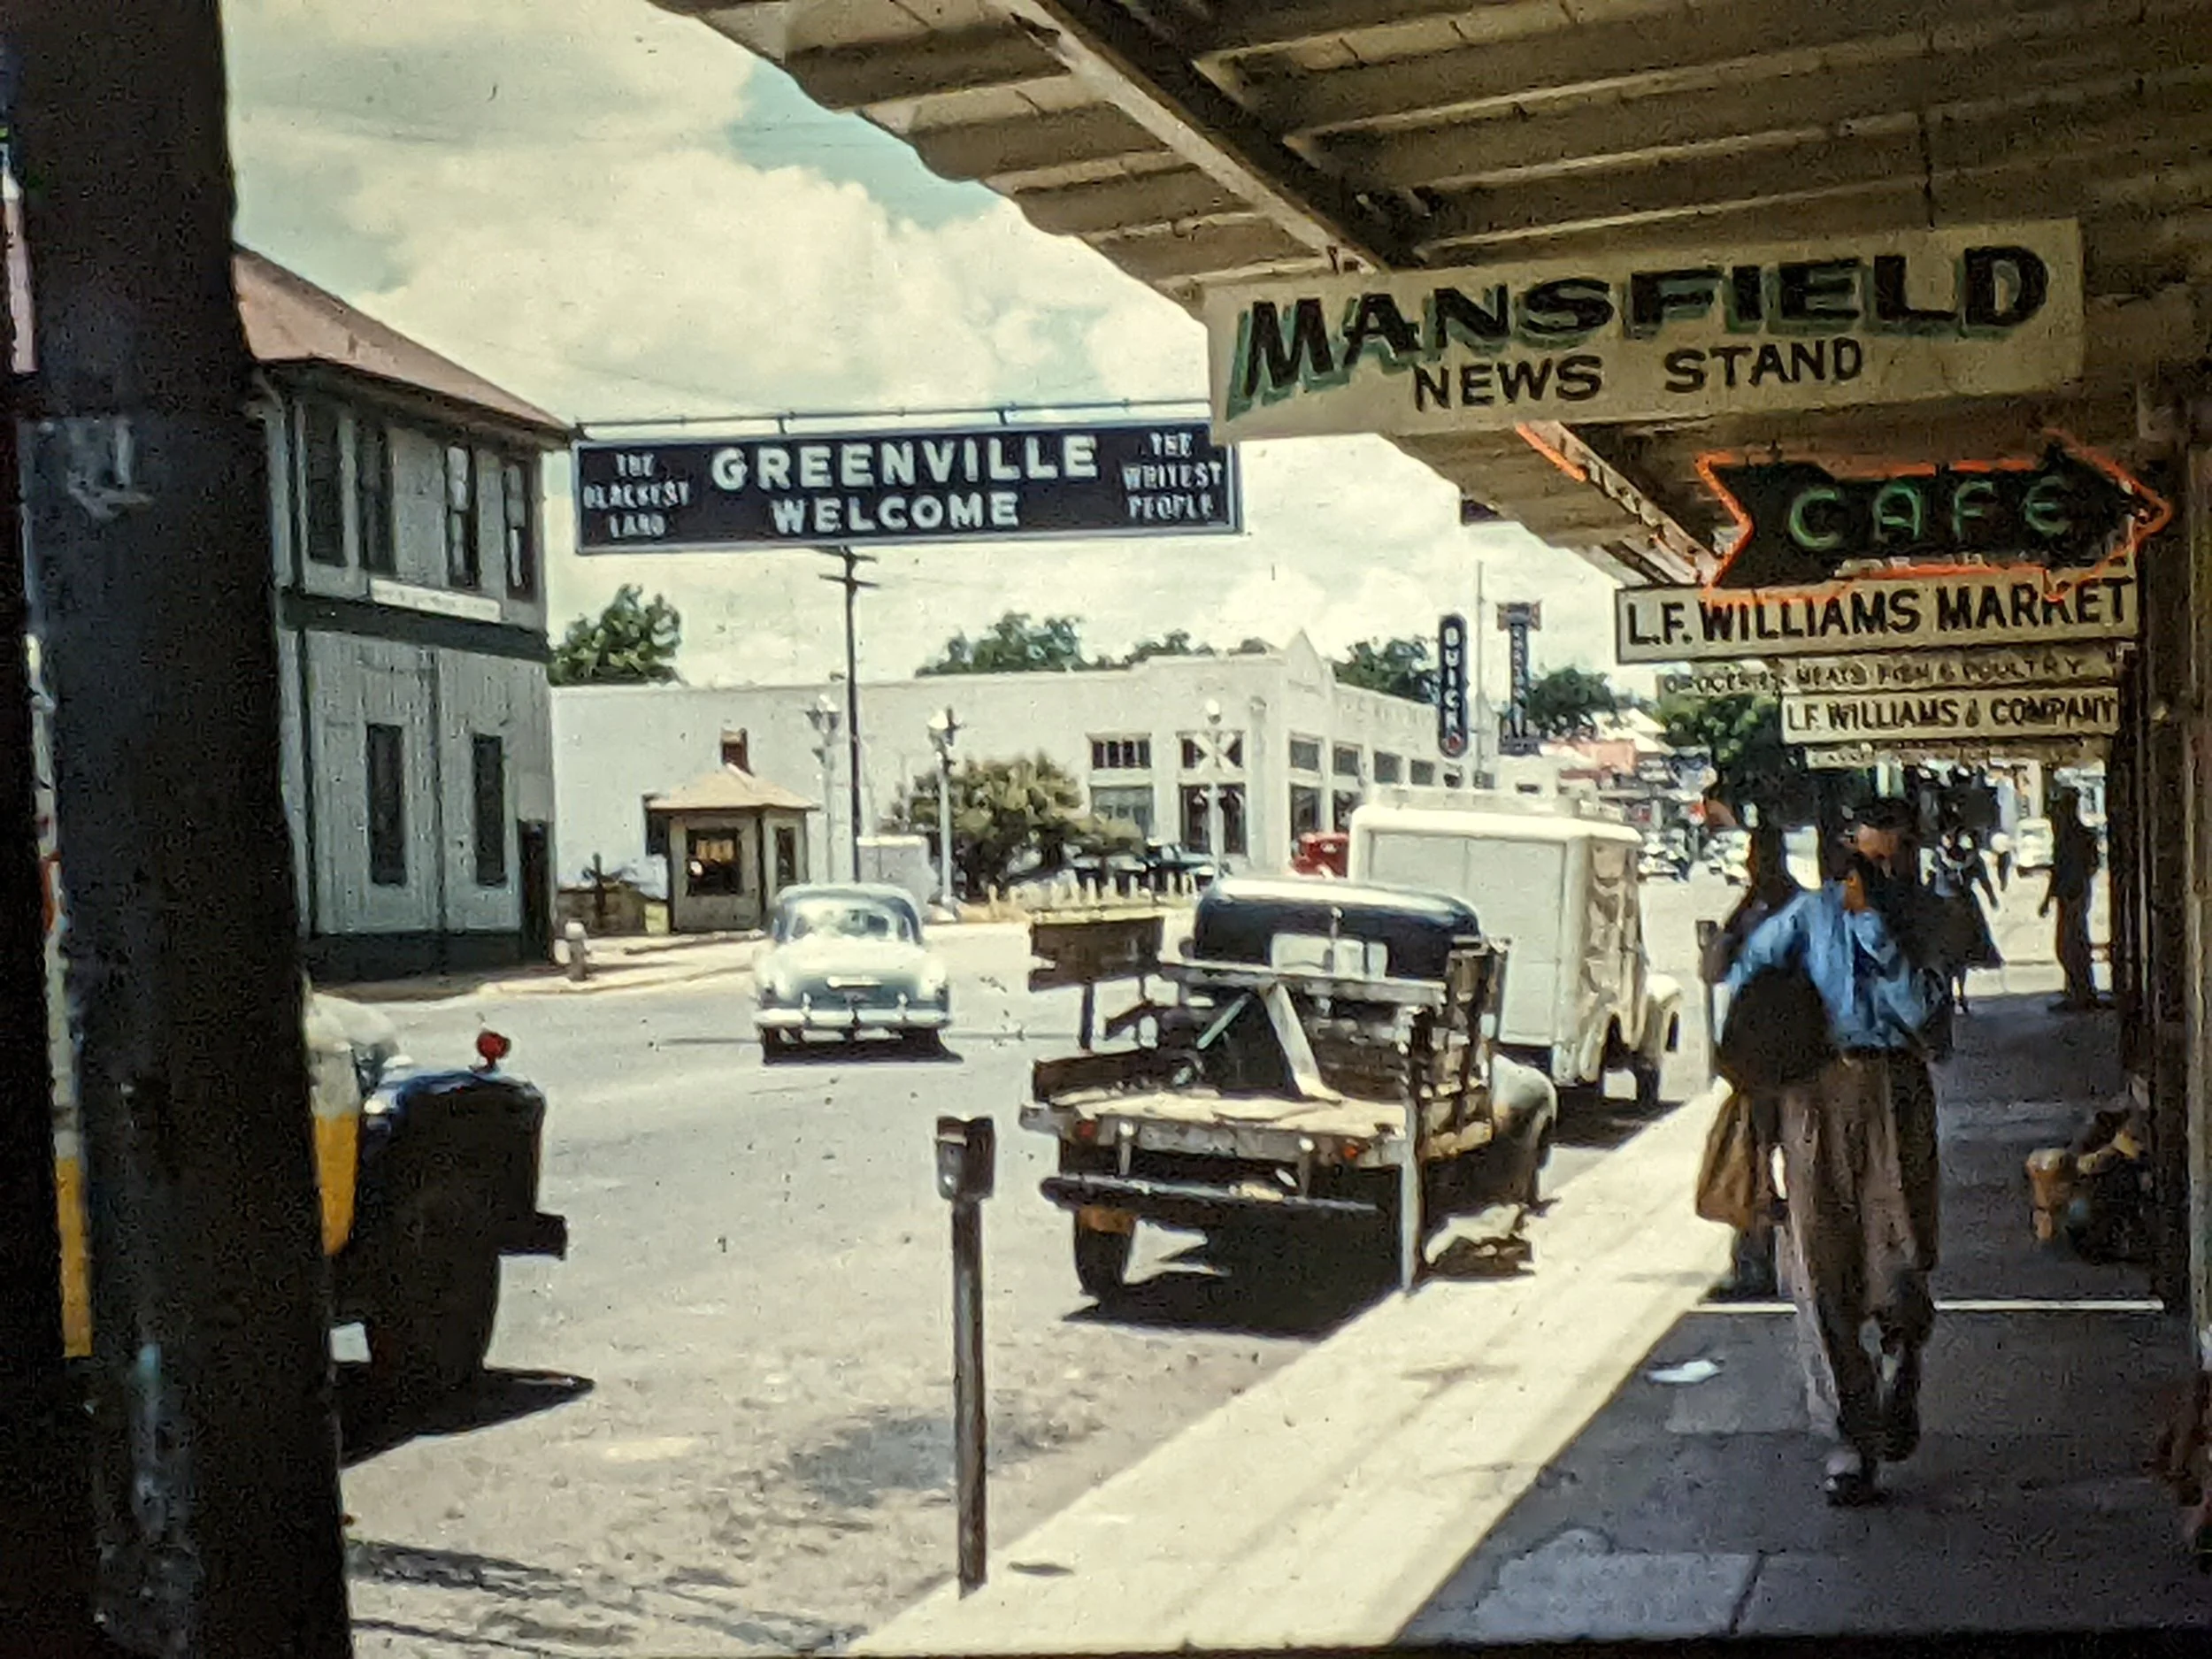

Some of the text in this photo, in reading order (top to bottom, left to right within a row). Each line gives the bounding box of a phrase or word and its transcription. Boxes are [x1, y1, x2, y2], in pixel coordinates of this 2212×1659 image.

[1228, 244, 2047, 419] MANSFIELD
[1416, 337, 1863, 411] NEWS STAND
[710, 432, 1098, 492] GREENVILLE
[771, 489, 1019, 534] WELCOME
[1788, 474, 2072, 551] CAFE
[1698, 587, 1922, 642] WILLIAMS
[1936, 575, 2135, 631] MARKET
